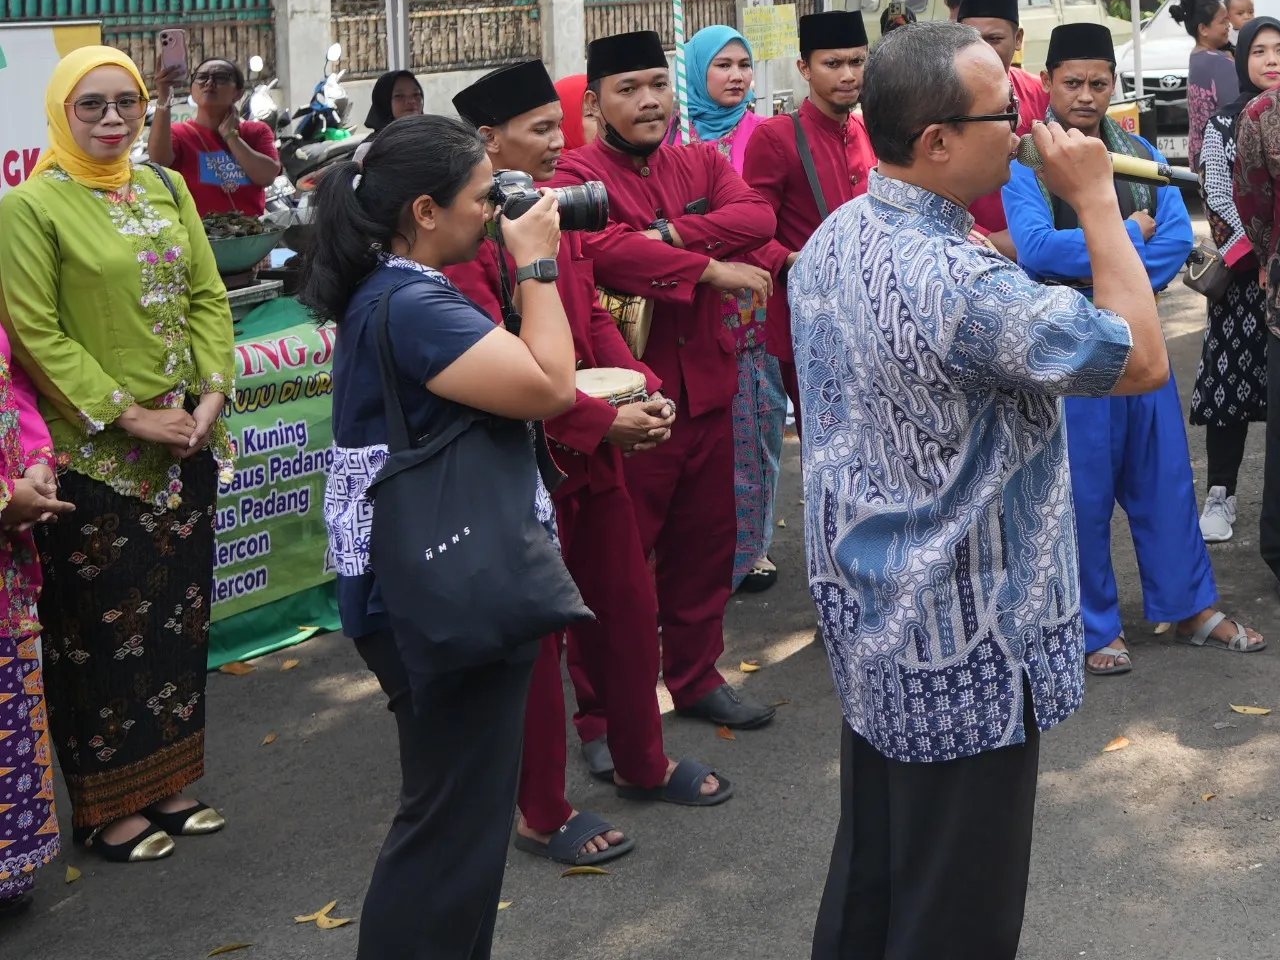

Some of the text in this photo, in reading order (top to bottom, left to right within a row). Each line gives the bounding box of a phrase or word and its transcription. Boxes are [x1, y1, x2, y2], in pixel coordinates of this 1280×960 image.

[1157, 138, 1175, 150] 671
[235, 326, 337, 376] ING J
[243, 421, 306, 455] Kuning
[269, 449, 334, 482] Padang
[215, 487, 310, 531] us Padang
